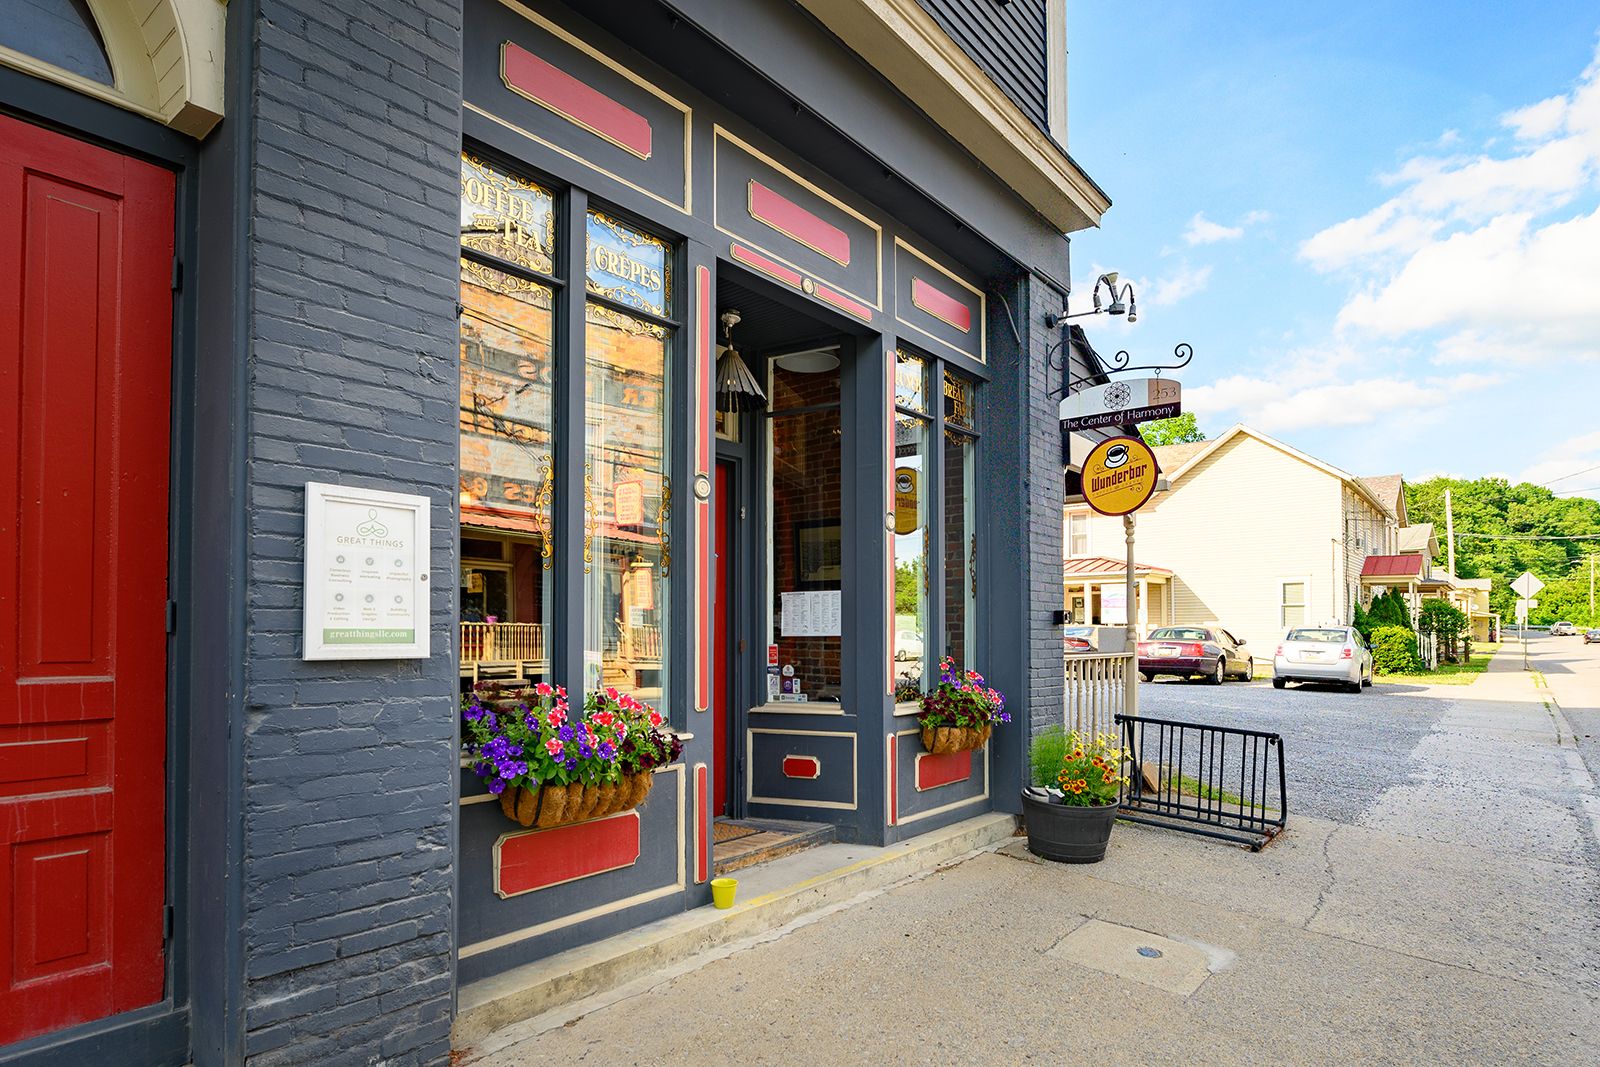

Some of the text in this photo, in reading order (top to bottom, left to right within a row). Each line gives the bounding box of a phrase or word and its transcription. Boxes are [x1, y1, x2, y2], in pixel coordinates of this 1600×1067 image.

[477, 214, 545, 254] AND TEA
[1153, 387, 1177, 400] 253
[1062, 405, 1174, 429] The Center of Harmony
[1091, 464, 1148, 492] Wunderbar
[336, 535, 366, 545] GREAT
[369, 538, 405, 548] THINGS
[329, 630, 408, 639] greatthingsllc.com
